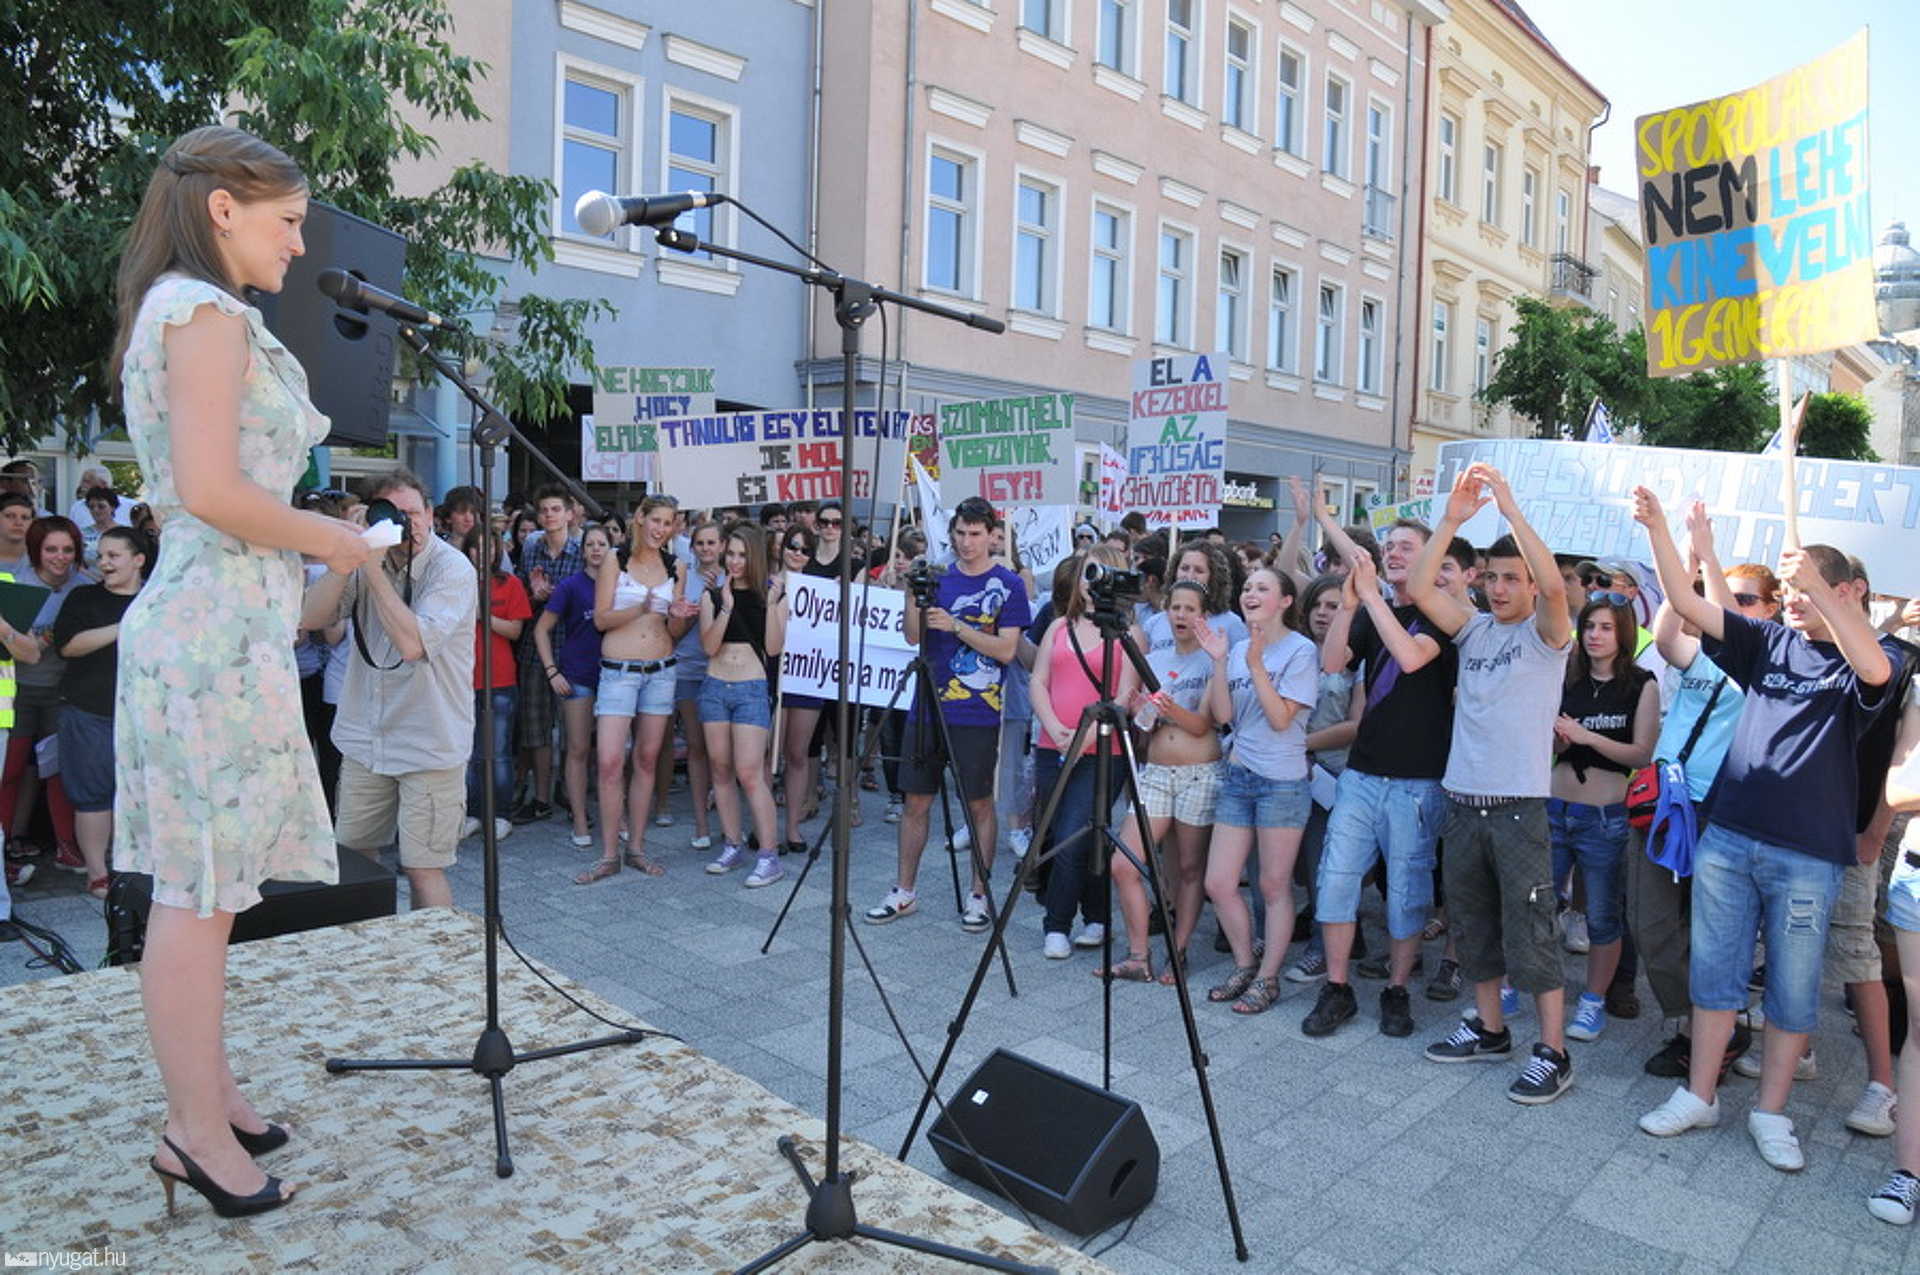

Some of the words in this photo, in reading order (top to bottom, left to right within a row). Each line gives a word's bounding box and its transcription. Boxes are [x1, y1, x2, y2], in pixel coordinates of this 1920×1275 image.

[1643, 155, 1757, 244] NEM
[1769, 110, 1868, 219] LEHET
[1150, 358, 1183, 386] EL
[1191, 355, 1213, 382] A
[763, 411, 807, 440] EGY
[1159, 415, 1197, 444] AZ
[758, 445, 791, 470] DE
[797, 443, 844, 468] HOL
[736, 472, 768, 504] ÉS
[853, 596, 889, 630] lsz
